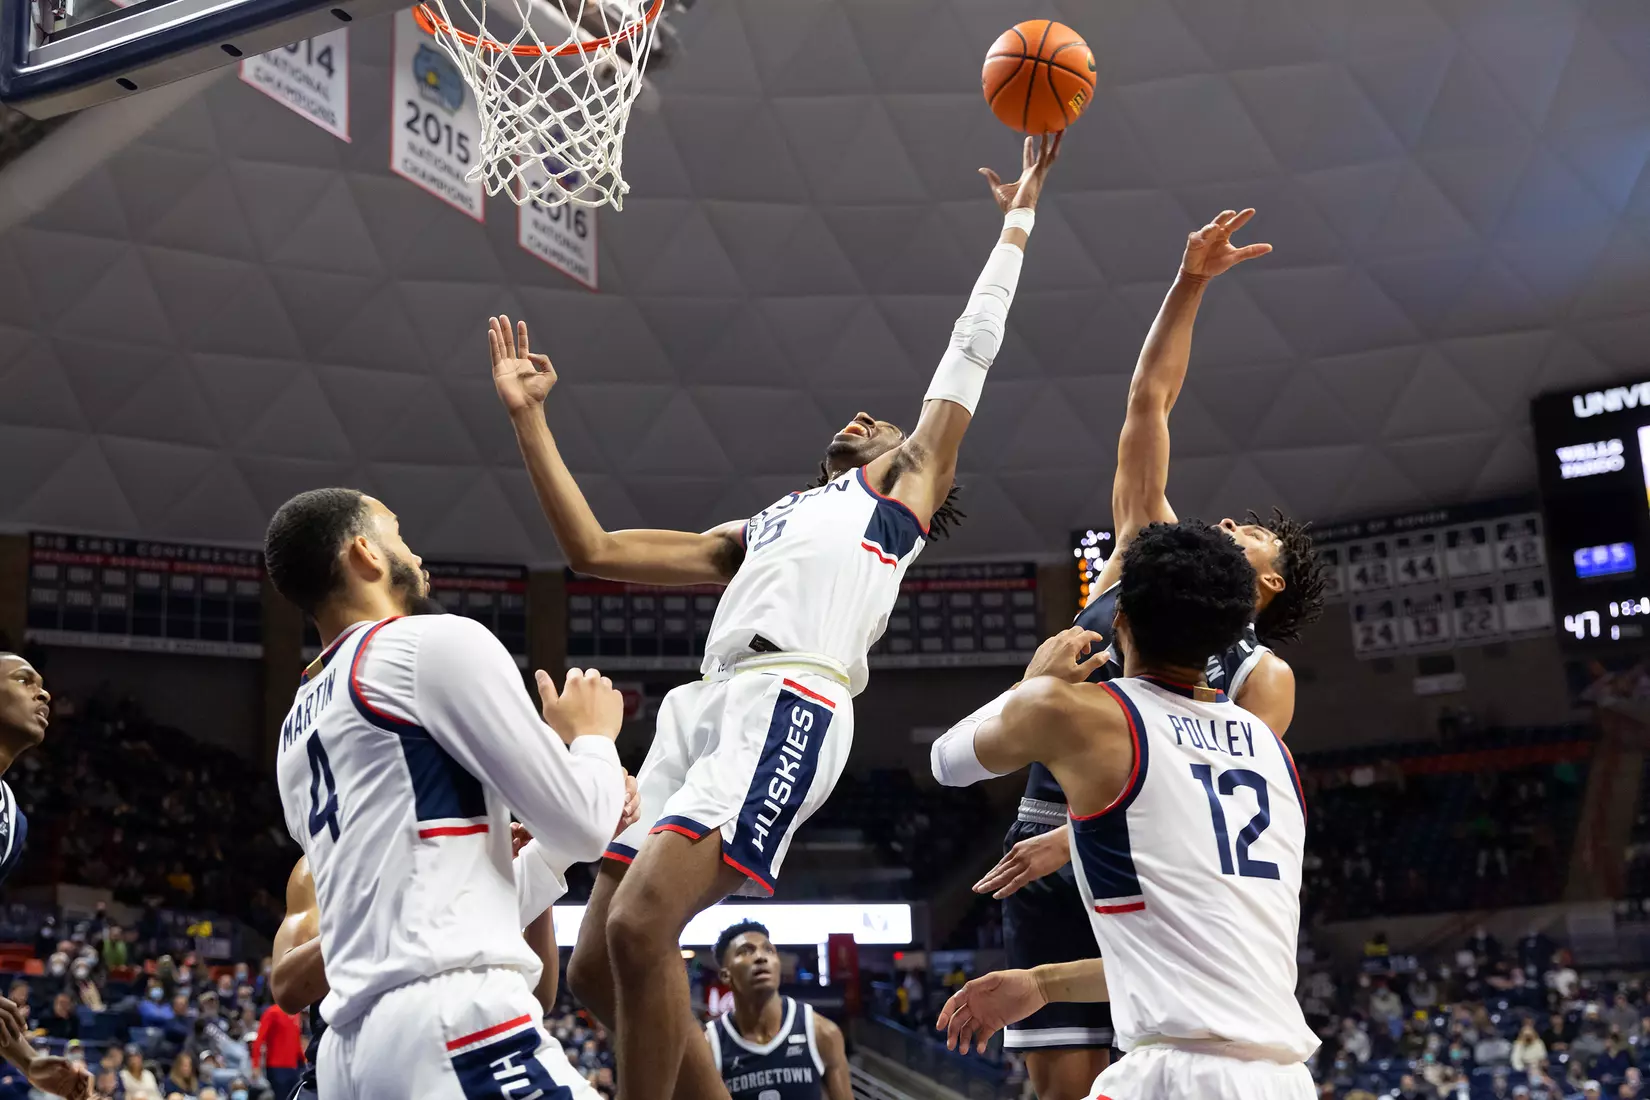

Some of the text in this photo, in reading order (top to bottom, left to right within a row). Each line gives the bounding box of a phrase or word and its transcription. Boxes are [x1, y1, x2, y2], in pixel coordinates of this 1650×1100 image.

[404, 99, 471, 165] 2015
[402, 157, 475, 211] CHAMPIONS
[531, 181, 588, 239] 2016
[283, 667, 337, 752] MARTIN
[1167, 713, 1256, 758] POLLEY
[306, 729, 341, 844] 4
[752, 705, 814, 853] HUSKIES
[1189, 763, 1281, 881] 12
